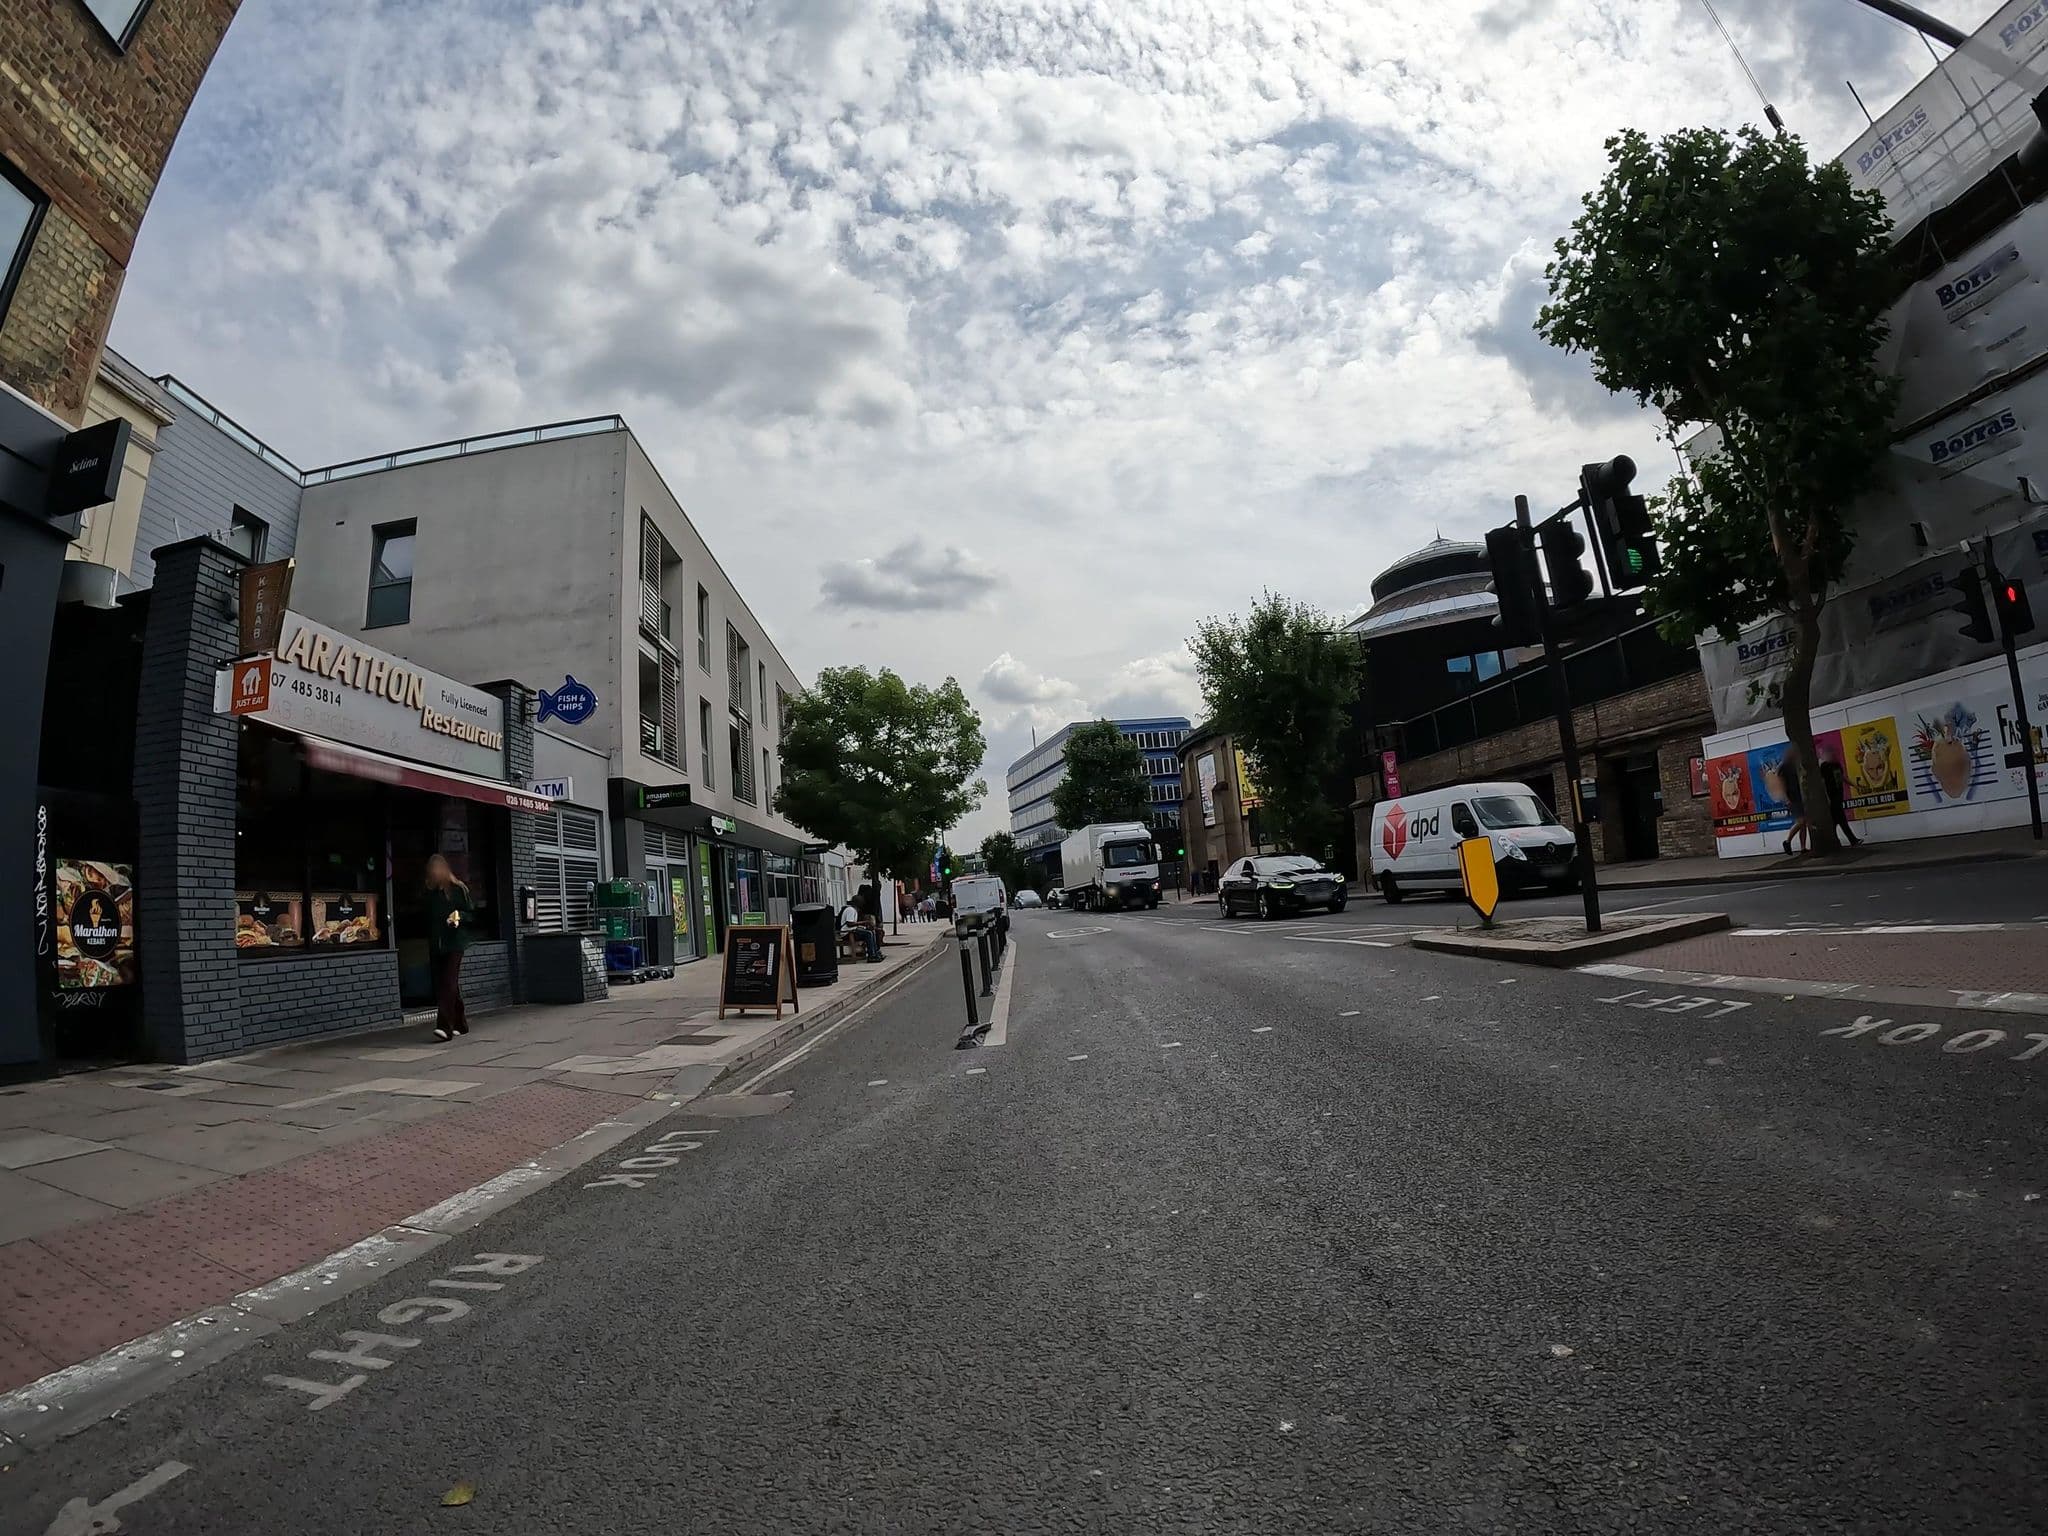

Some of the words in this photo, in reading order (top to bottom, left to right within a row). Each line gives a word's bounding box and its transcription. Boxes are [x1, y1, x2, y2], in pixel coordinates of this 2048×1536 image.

[1857, 108, 1927, 175] Borras
[1929, 412, 2016, 462] Borras
[253, 575, 268, 640] KEBAB
[235, 698, 251, 709] JUST
[252, 695, 265, 706] EAT
[315, 686, 342, 706] 3814
[441, 690, 459, 709] Fully
[460, 696, 488, 716] Licenced
[557, 702, 583, 711] CHIPS
[558, 694, 577, 703] FISH
[580, 694, 586, 702] &
[421, 704, 503, 751] Restaurant
[534, 783, 564, 797] ATM
[1846, 797, 1866, 809] ENJOY
[1867, 796, 1879, 805] THE
[1880, 794, 1896, 803] RIDE
[1411, 808, 1440, 844] dpd
[73, 924, 118, 938] Marathon
[86, 937, 106, 946] KEBABS
[1593, 990, 1753, 1019] LEFT
[1818, 1015, 2048, 1061] LOOK
[583, 1130, 720, 1190] LOOK
[262, 1252, 546, 1411] RIGHT
